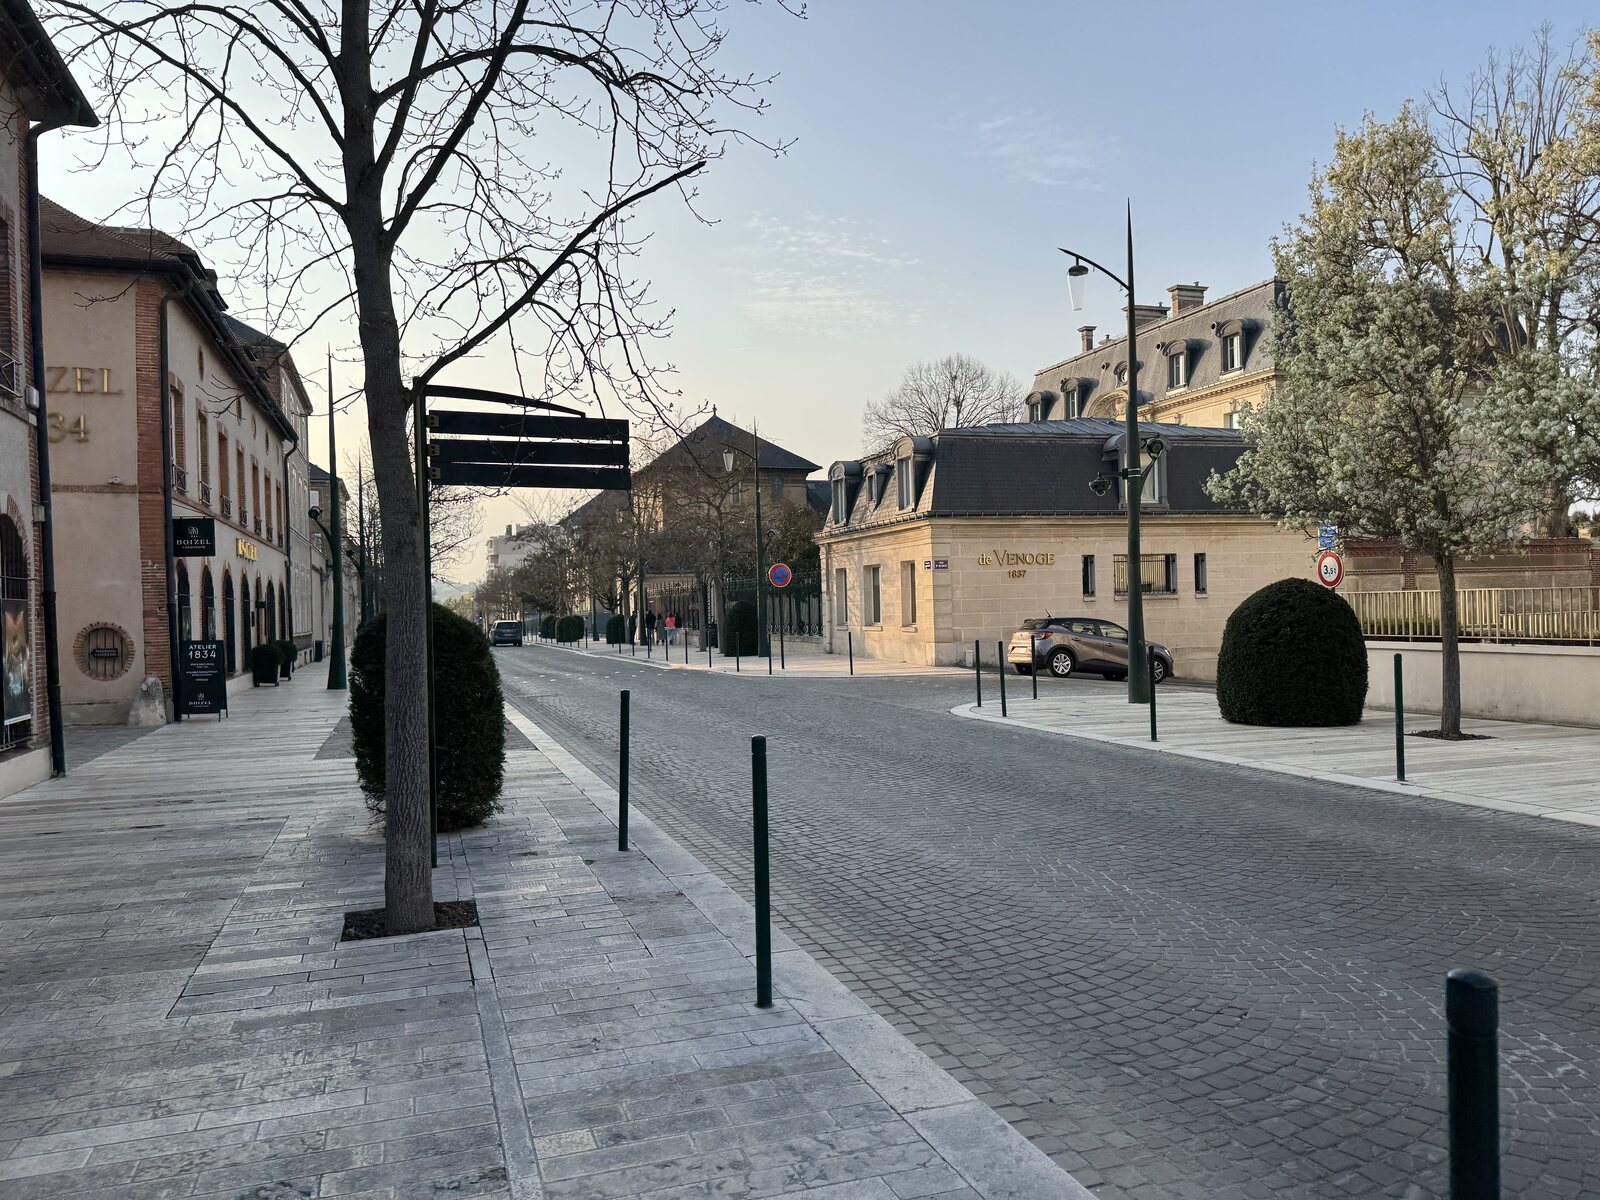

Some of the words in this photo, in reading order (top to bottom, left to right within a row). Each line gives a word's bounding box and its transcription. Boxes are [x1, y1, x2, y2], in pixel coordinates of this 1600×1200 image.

[978, 553, 992, 565] de
[993, 549, 1055, 566] VENOGE
[1008, 570, 1026, 578] 1837
[188, 650, 216, 659] 1834
